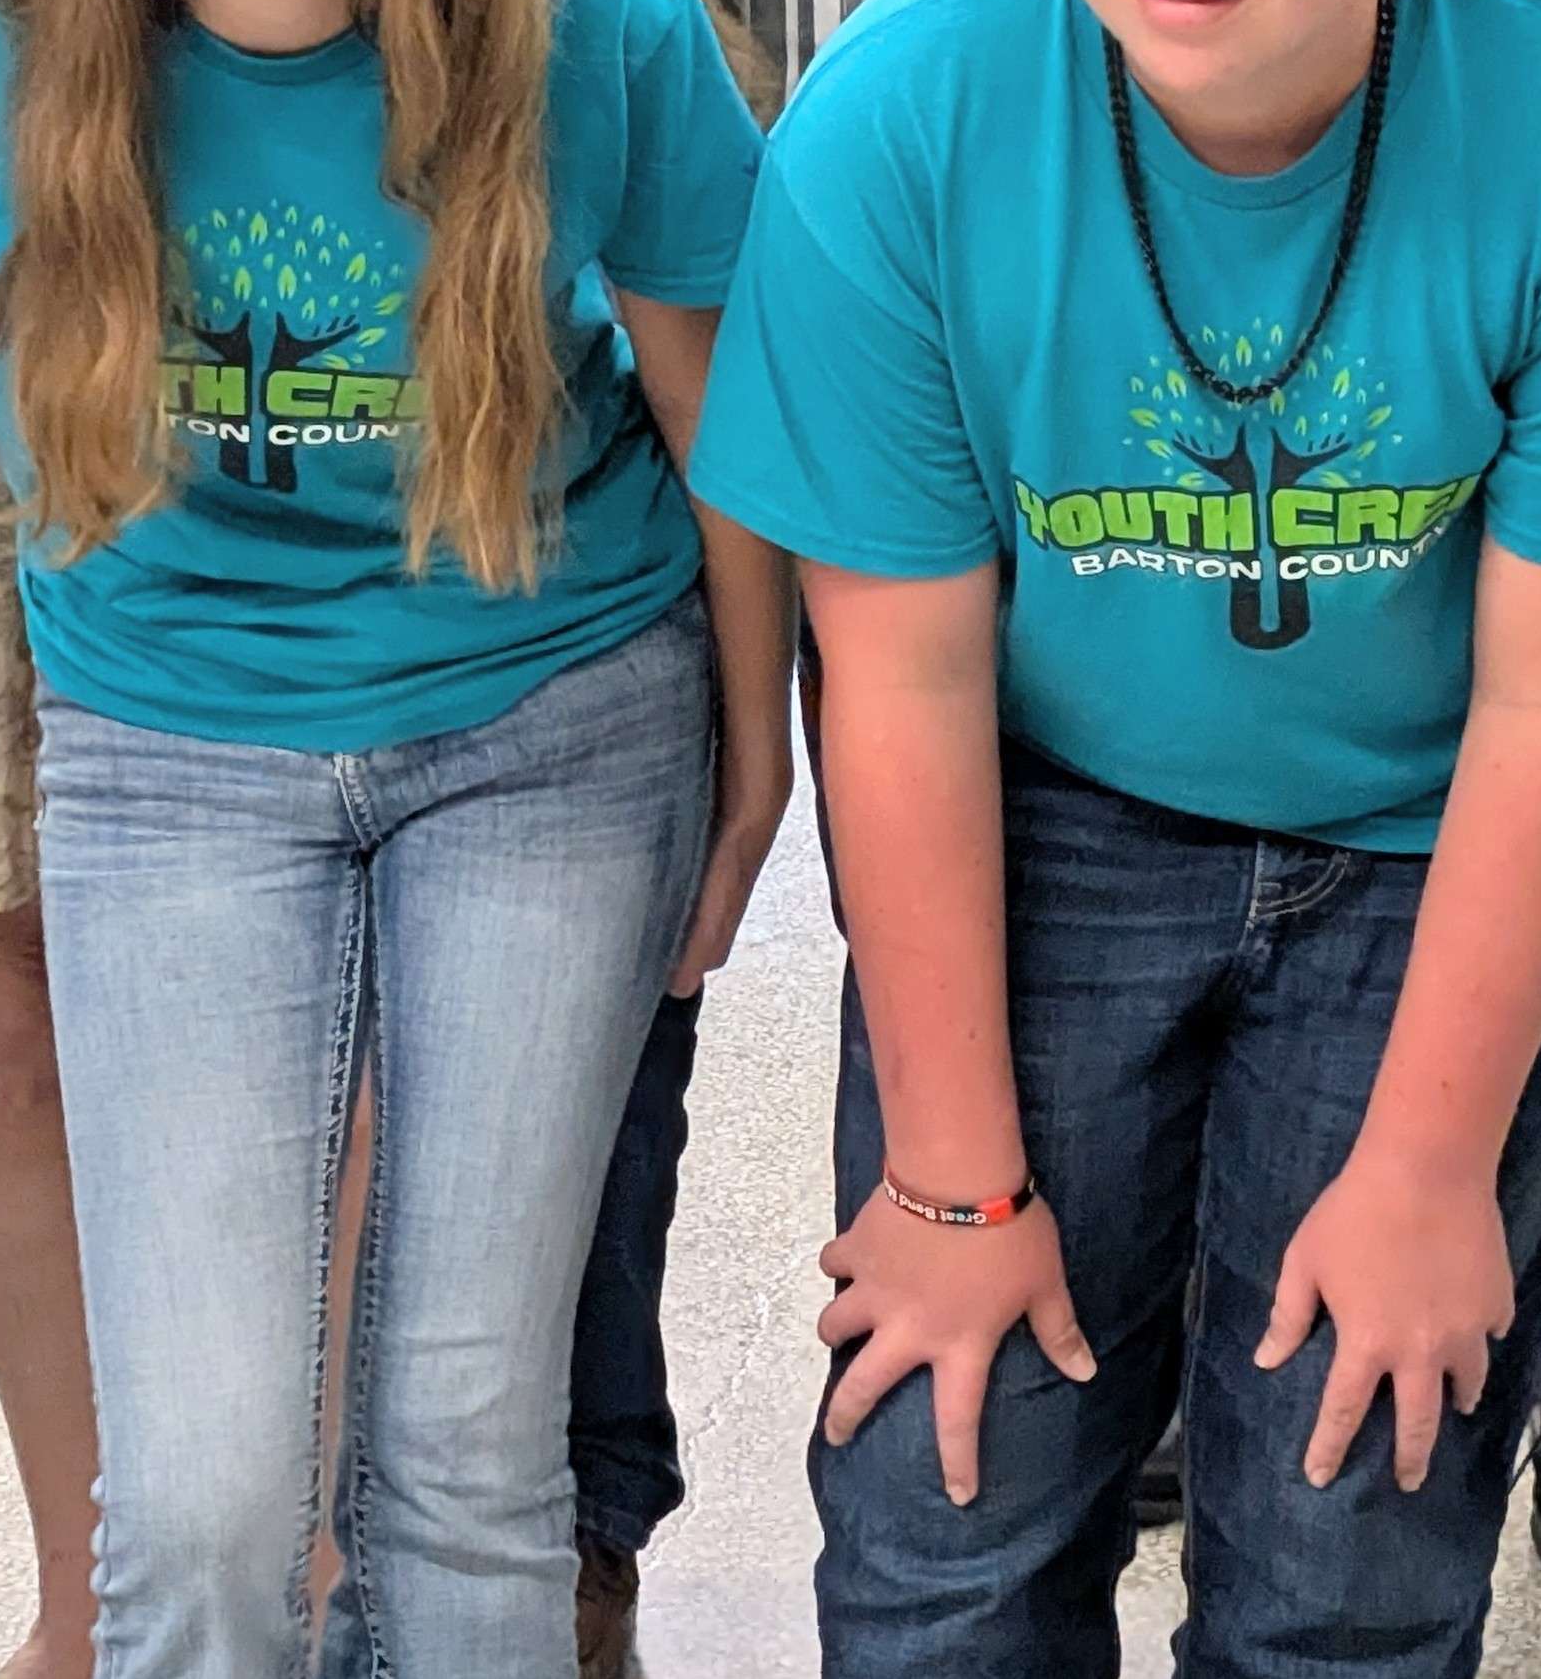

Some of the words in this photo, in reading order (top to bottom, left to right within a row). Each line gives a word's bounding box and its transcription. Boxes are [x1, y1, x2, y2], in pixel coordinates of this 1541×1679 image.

[266, 370, 431, 418] CR
[268, 422, 401, 446] COUN
[1015, 479, 1255, 552] YOUTH
[1071, 548, 1262, 580] BARTON
